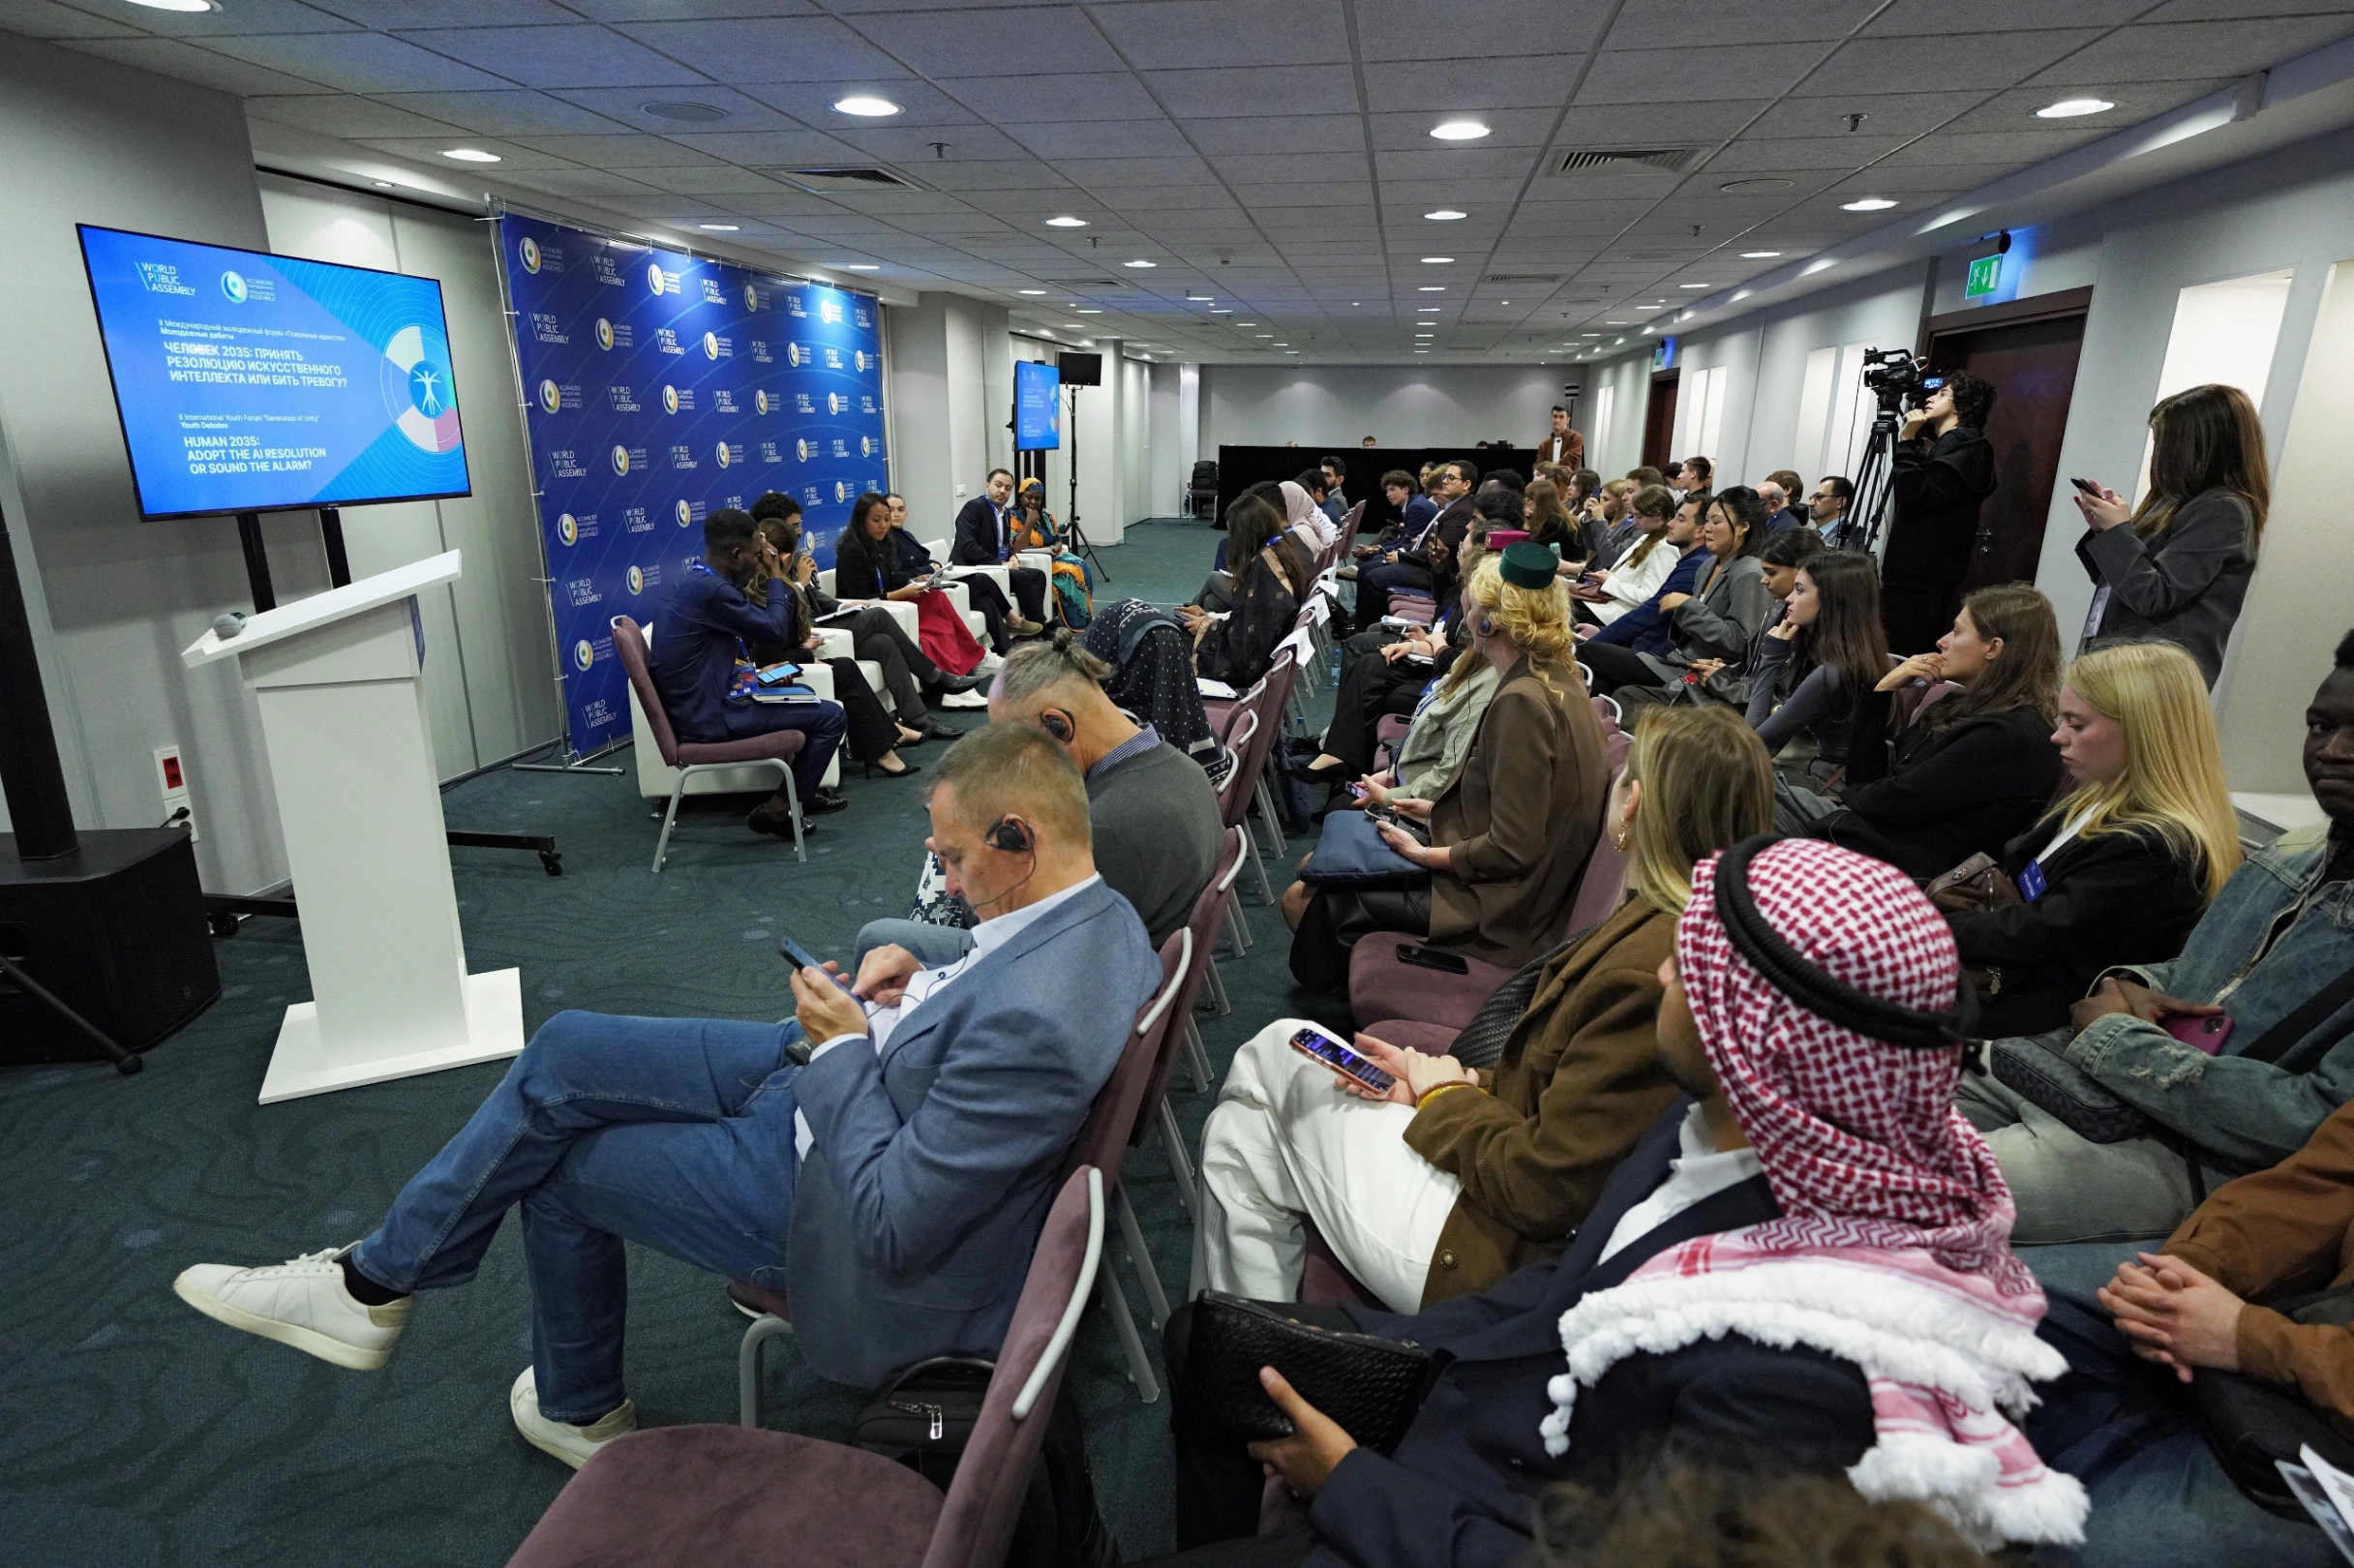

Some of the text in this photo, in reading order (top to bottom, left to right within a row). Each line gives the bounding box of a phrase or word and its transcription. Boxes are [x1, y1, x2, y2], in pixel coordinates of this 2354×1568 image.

[141, 262, 176, 275] WORLD
[148, 273, 180, 286] PUBLIC
[599, 276, 625, 286] ASSEMBLY
[152, 284, 196, 296] ASSEMBLY
[165, 319, 222, 331] Международный
[160, 327, 208, 338] Молодежные
[539, 334, 568, 345] ASSEMBLY
[164, 342, 303, 361] ЧЕЛОВЕК 2035: ПРИНЯТЬ
[663, 347, 684, 355] ASSEMBLY
[166, 356, 341, 376] РЕЗОЛЮЦИЮ ИСКУССТВЕННОГО
[169, 371, 347, 388] ИНТЕЛЛЕКТА ИЛИ БИТЬ ТРЕВОГУ?
[616, 404, 640, 412] ASSEMBLY
[184, 437, 259, 447] HUMAN 2035:
[188, 448, 326, 462] ADOPT THE AI RESOLUTION
[190, 461, 312, 474] OR SOUND THE ALARM?
[558, 468, 586, 478] ASSEMBLY
[631, 523, 654, 532] ASSEMBLY
[573, 587, 592, 598] PUBLIC
[575, 593, 602, 606] ASSEMBLY
[590, 712, 617, 728] ASSEMBLY
